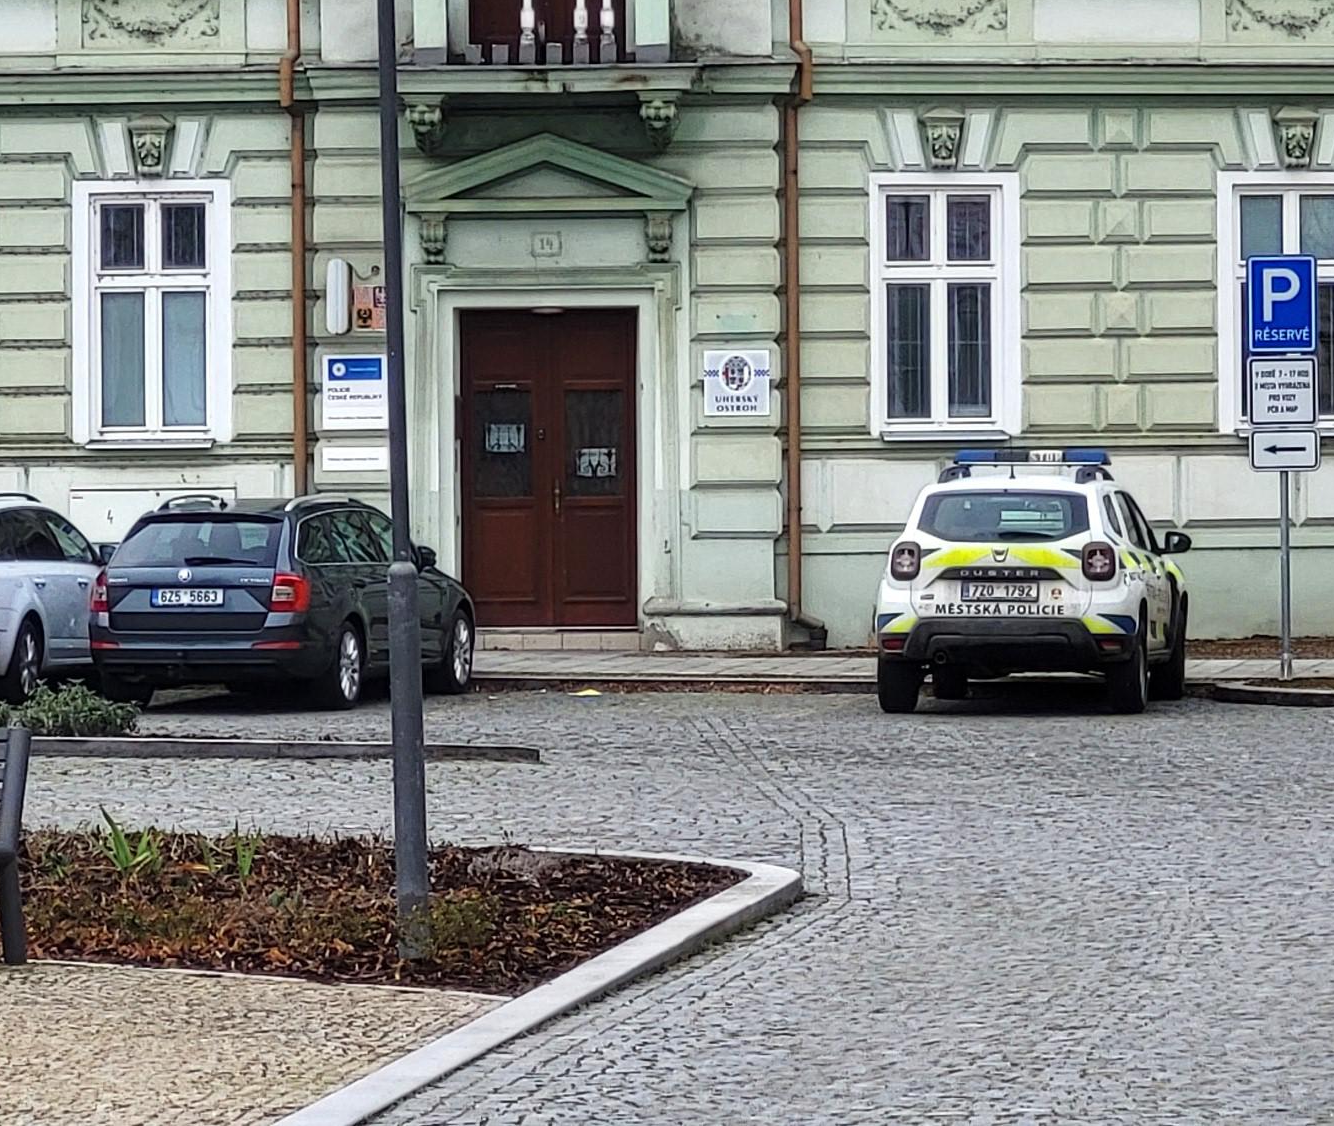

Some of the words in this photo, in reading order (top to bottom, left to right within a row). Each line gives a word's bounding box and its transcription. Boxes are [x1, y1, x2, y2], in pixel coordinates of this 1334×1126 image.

[1262, 267, 1301, 323] P
[1254, 326, 1311, 342] RÉSERVÉ
[959, 569, 1040, 577] DUSTER
[160, 590, 181, 602] 6Z5
[190, 590, 218, 602] 5663
[1003, 584, 1033, 597] 1792
[934, 602, 1003, 615] MĚSTSKÁ
[1007, 604, 1065, 615] POLICIE
